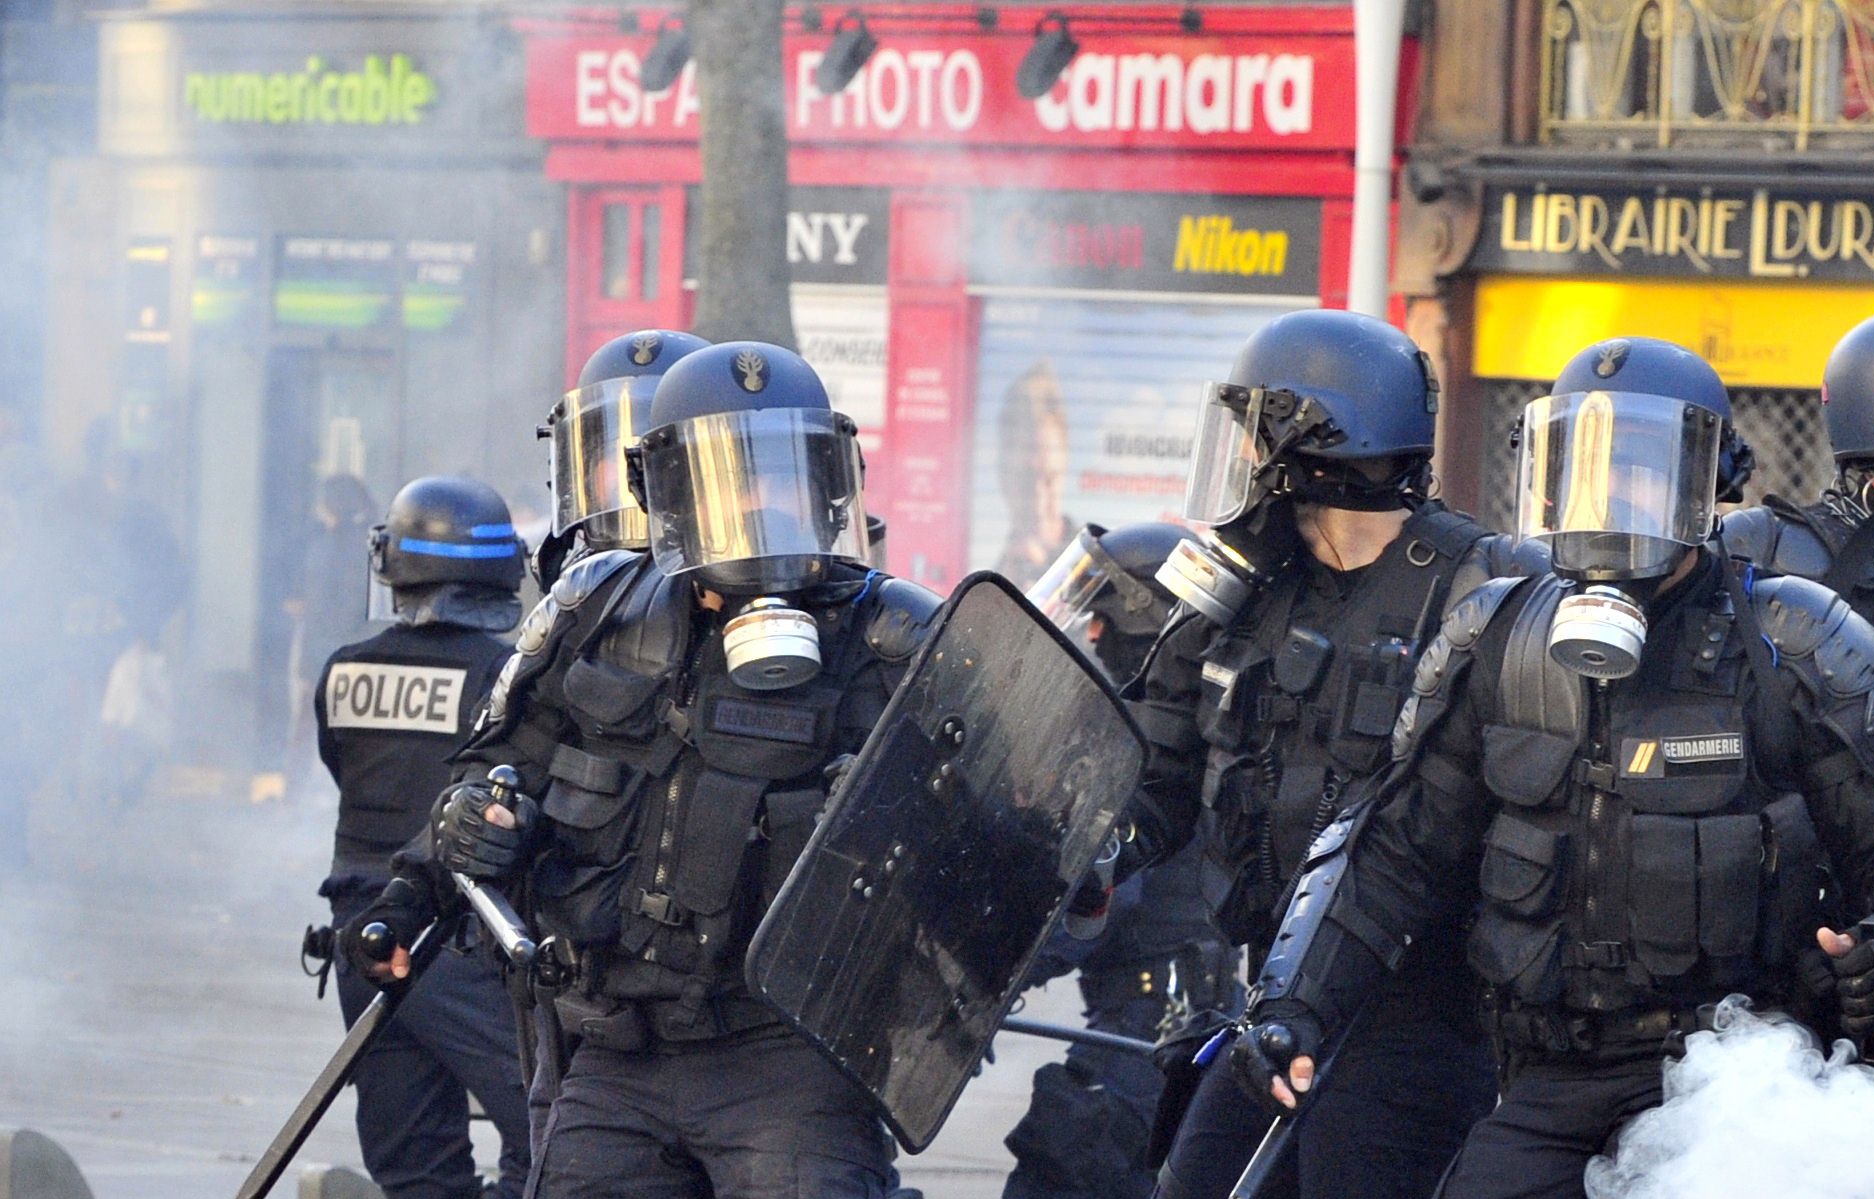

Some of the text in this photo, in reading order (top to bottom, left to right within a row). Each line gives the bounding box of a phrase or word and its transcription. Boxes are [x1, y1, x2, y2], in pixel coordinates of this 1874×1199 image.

[1172, 214, 1290, 277] Nikon
[1500, 183, 1745, 271] LIBRAIRIE
[332, 672, 453, 723] POLICE
[1663, 738, 1741, 758] GENDARMERIE
